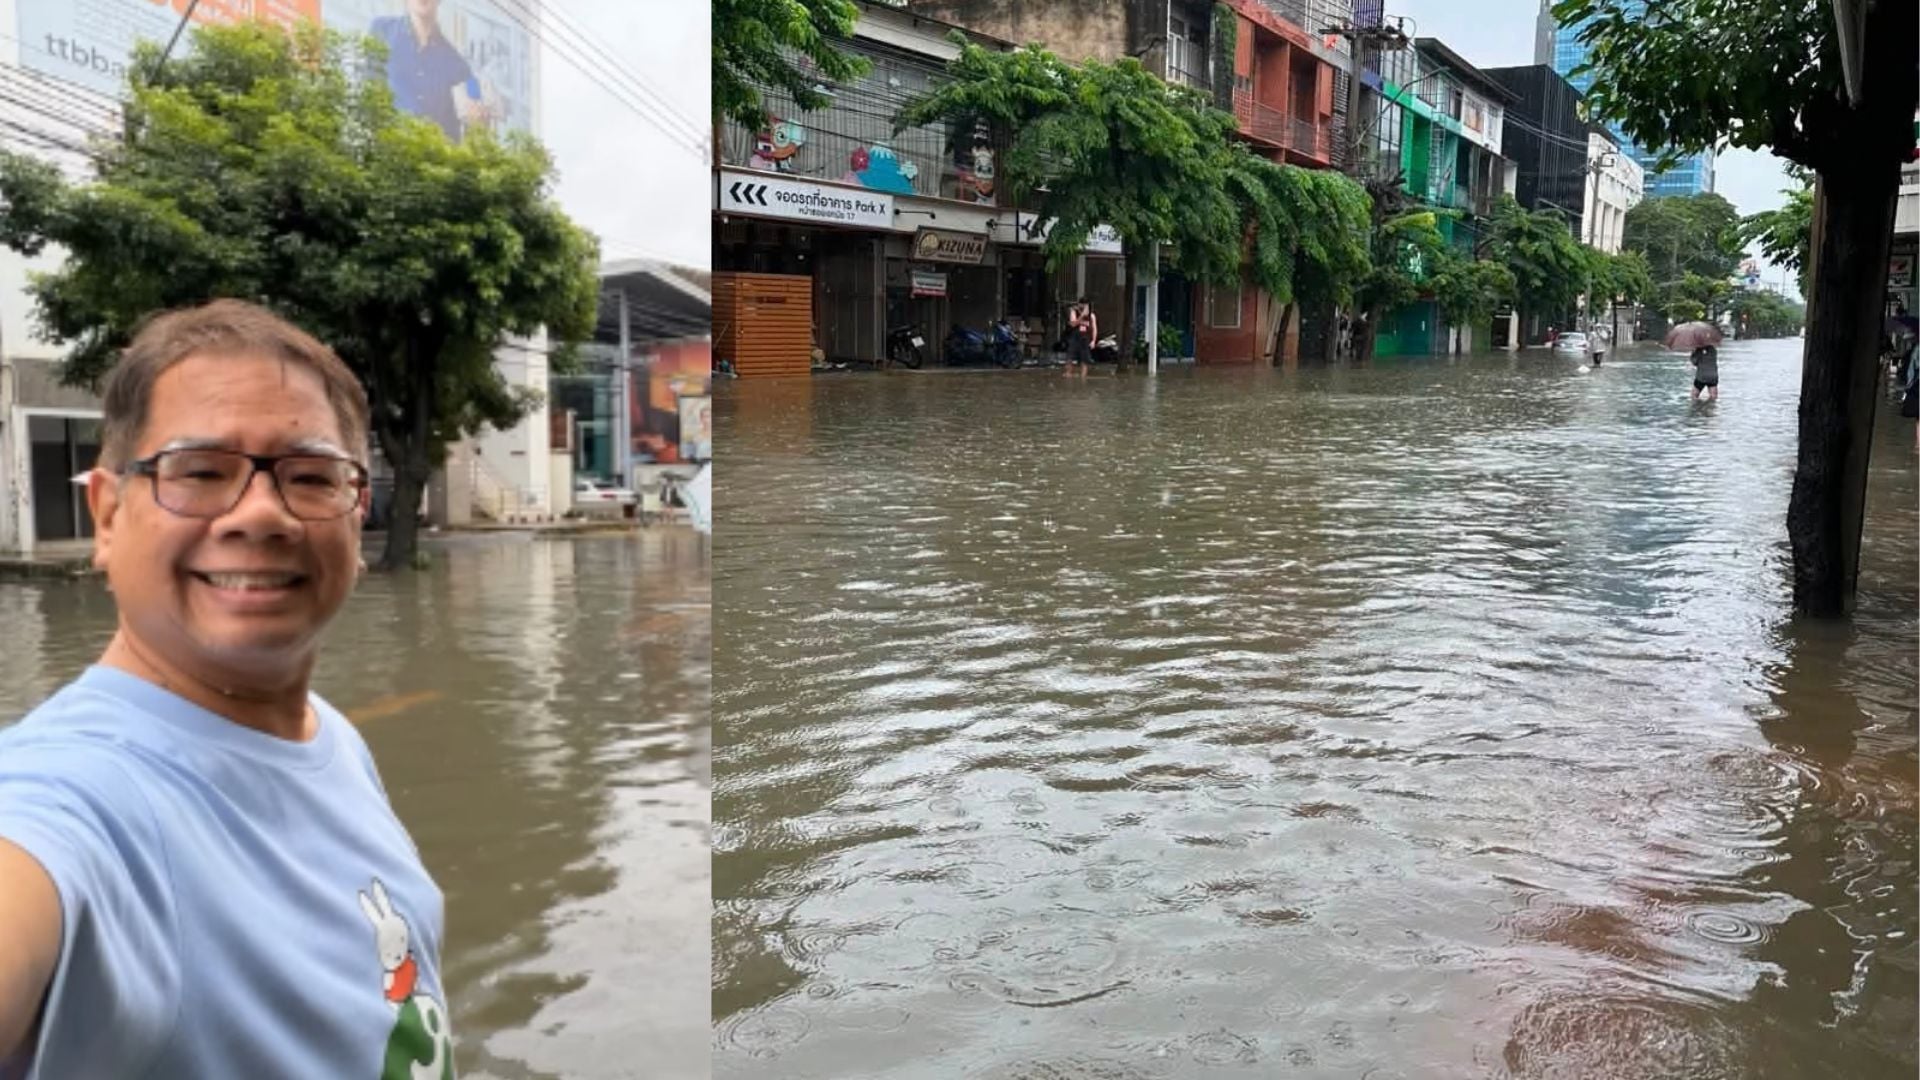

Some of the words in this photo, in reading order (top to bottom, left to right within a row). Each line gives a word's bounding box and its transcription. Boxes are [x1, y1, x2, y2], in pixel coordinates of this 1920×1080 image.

[775, 189, 852, 210] จอดรถที่อาคาร
[855, 200, 876, 214] Park
[879, 202, 886, 215] X
[937, 239, 983, 256] KIZUNA
